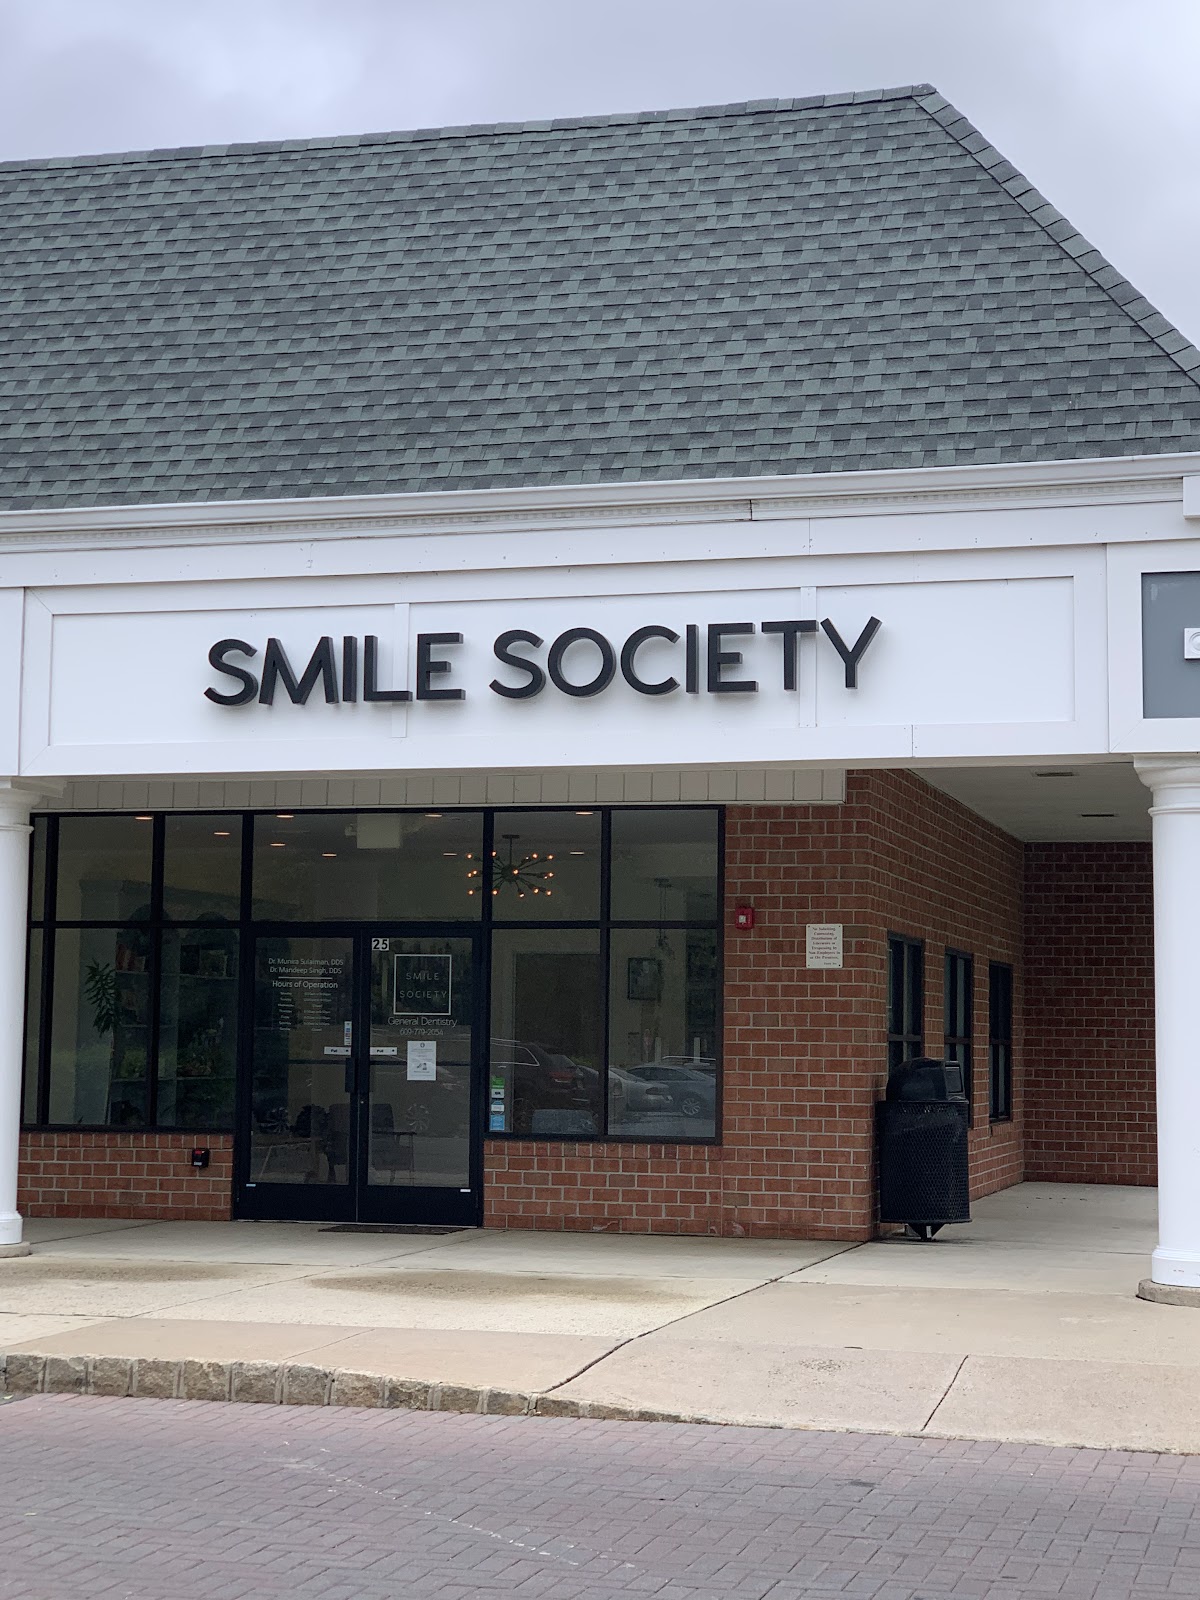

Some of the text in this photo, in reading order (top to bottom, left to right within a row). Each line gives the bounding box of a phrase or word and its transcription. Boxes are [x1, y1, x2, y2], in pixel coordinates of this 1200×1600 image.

[203, 615, 882, 706] SMILE SOCIETY
[372, 939, 388, 950] 25
[406, 972, 440, 981] SMILE
[272, 980, 339, 990] Hours of Operation
[399, 990, 447, 999] SOCIETY
[387, 1016, 458, 1028] General Dentistry
